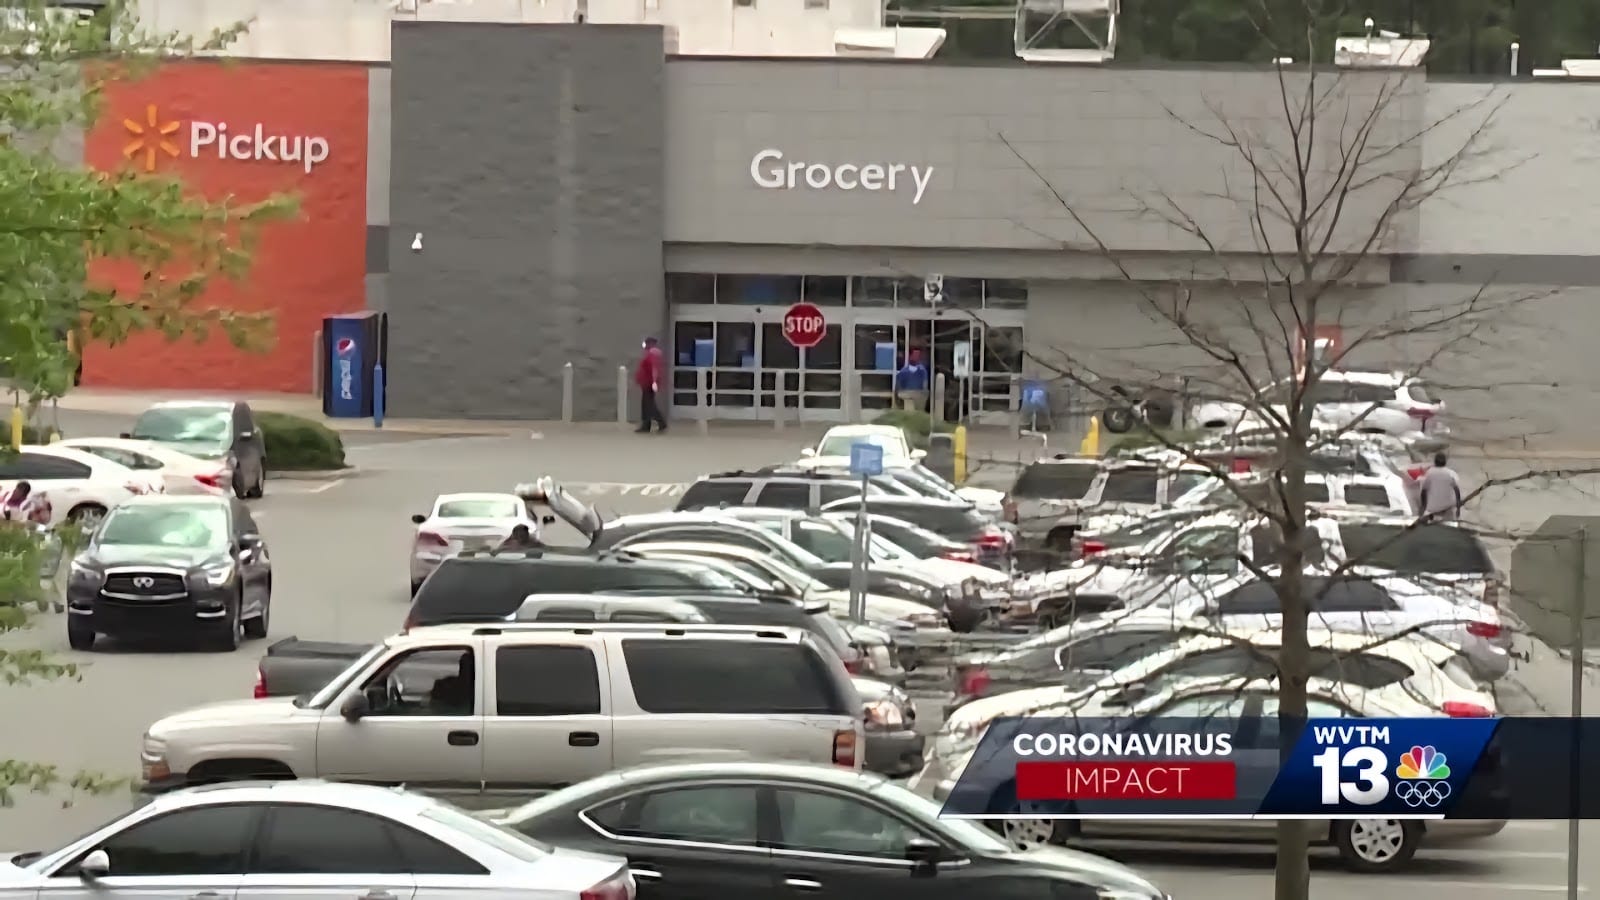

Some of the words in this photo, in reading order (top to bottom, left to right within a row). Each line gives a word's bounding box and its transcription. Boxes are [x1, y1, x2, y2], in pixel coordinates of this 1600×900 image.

[190, 121, 329, 174] Pickup
[750, 148, 934, 205] Grocery
[785, 315, 823, 334] STOP
